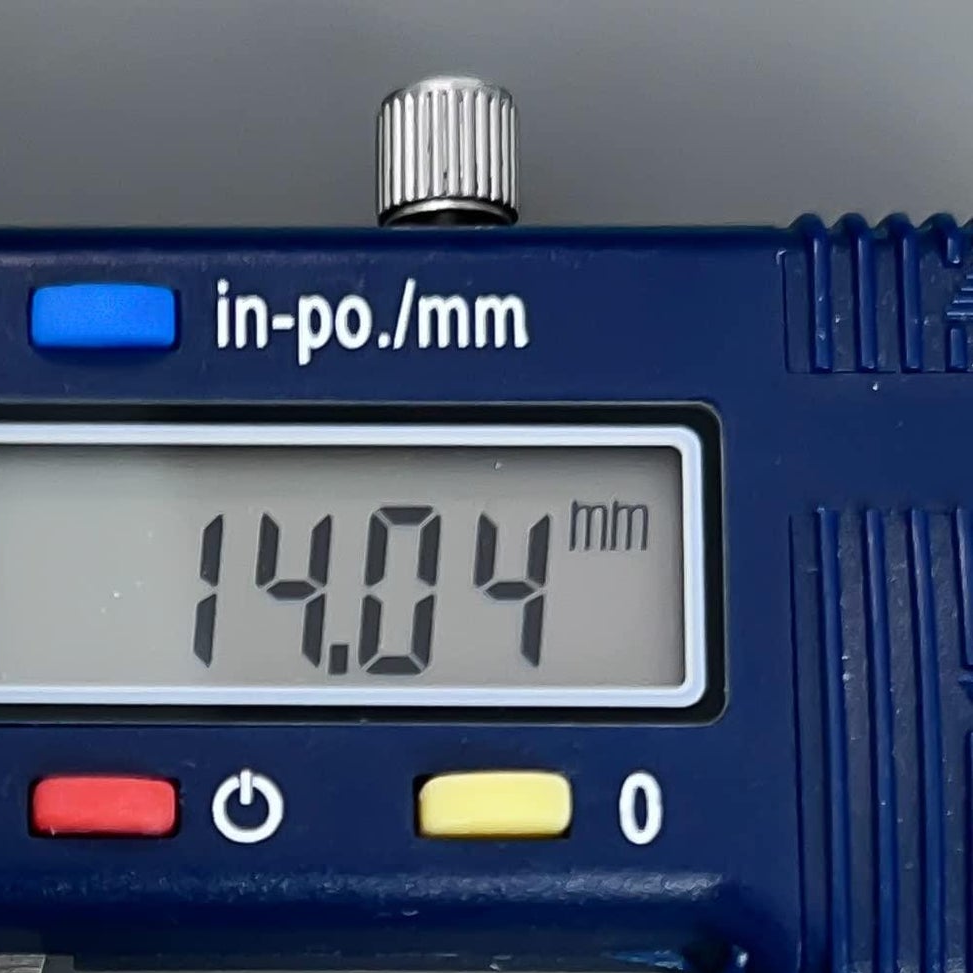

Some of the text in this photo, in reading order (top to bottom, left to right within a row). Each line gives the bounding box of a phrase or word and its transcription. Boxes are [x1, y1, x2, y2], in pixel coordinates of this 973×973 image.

[214, 279, 530, 365] in-po./mm
[192, 499, 649, 676] 14.04 mm
[618, 769, 663, 845] 0
